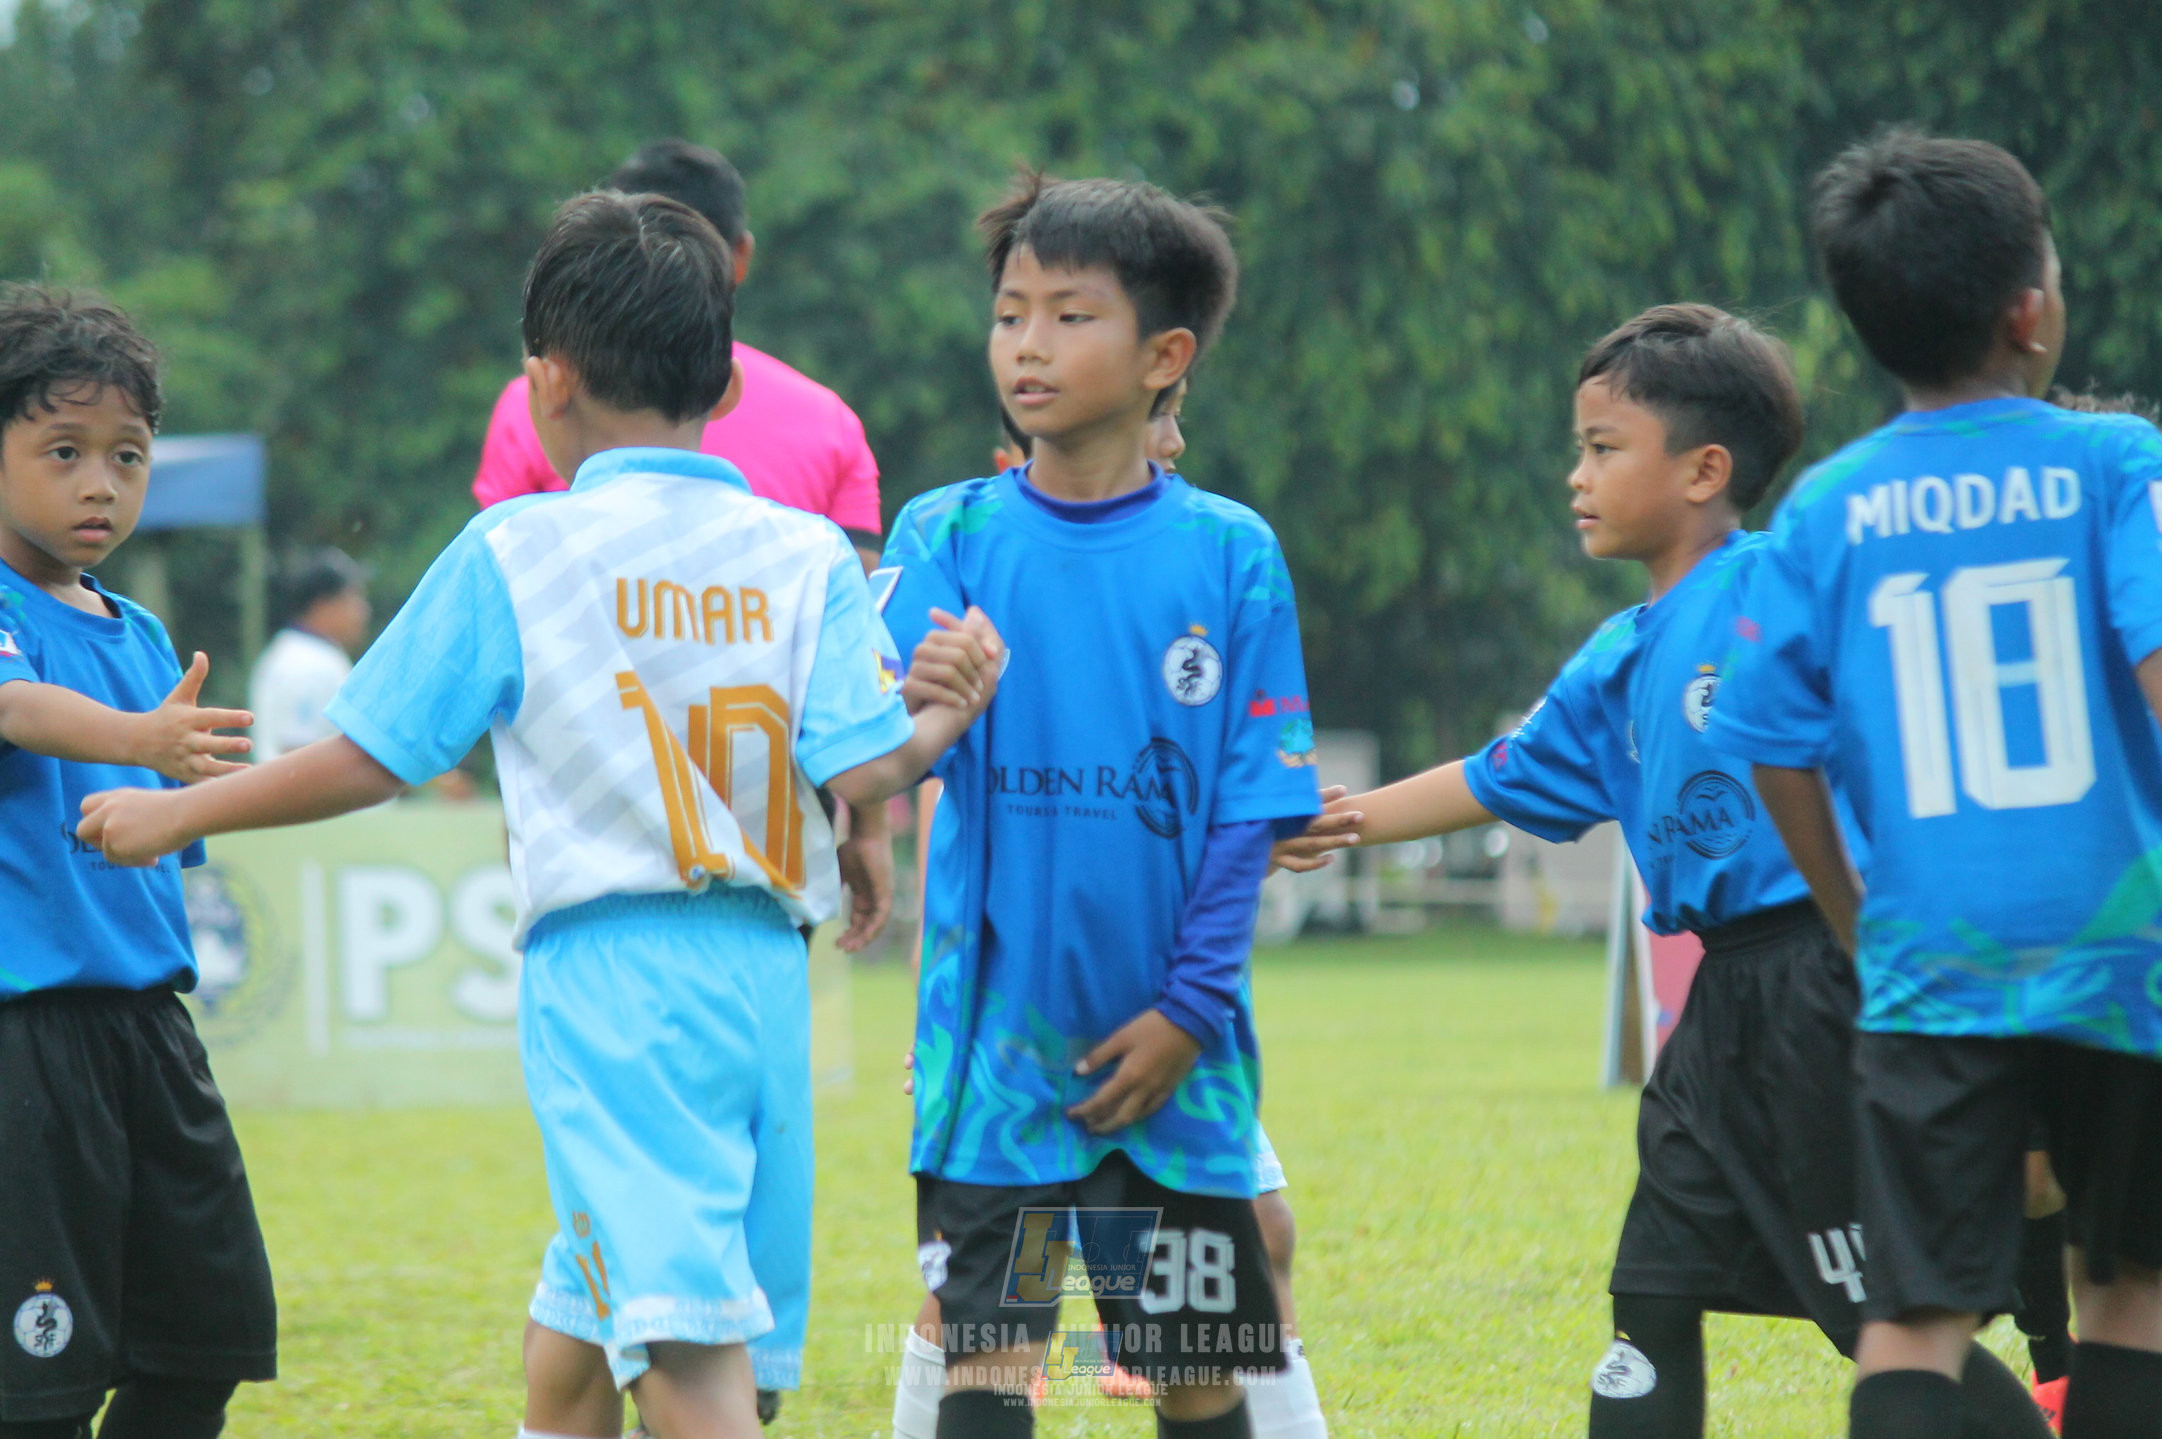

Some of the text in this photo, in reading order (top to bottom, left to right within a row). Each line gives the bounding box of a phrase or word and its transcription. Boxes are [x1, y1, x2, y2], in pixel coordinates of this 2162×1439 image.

[1846, 466, 2082, 545] MIQDAD
[616, 577, 774, 645] UMAR
[615, 671, 806, 900] 10
[1096, 765, 1177, 808] RAM
[1139, 1227, 1237, 1314] 38
